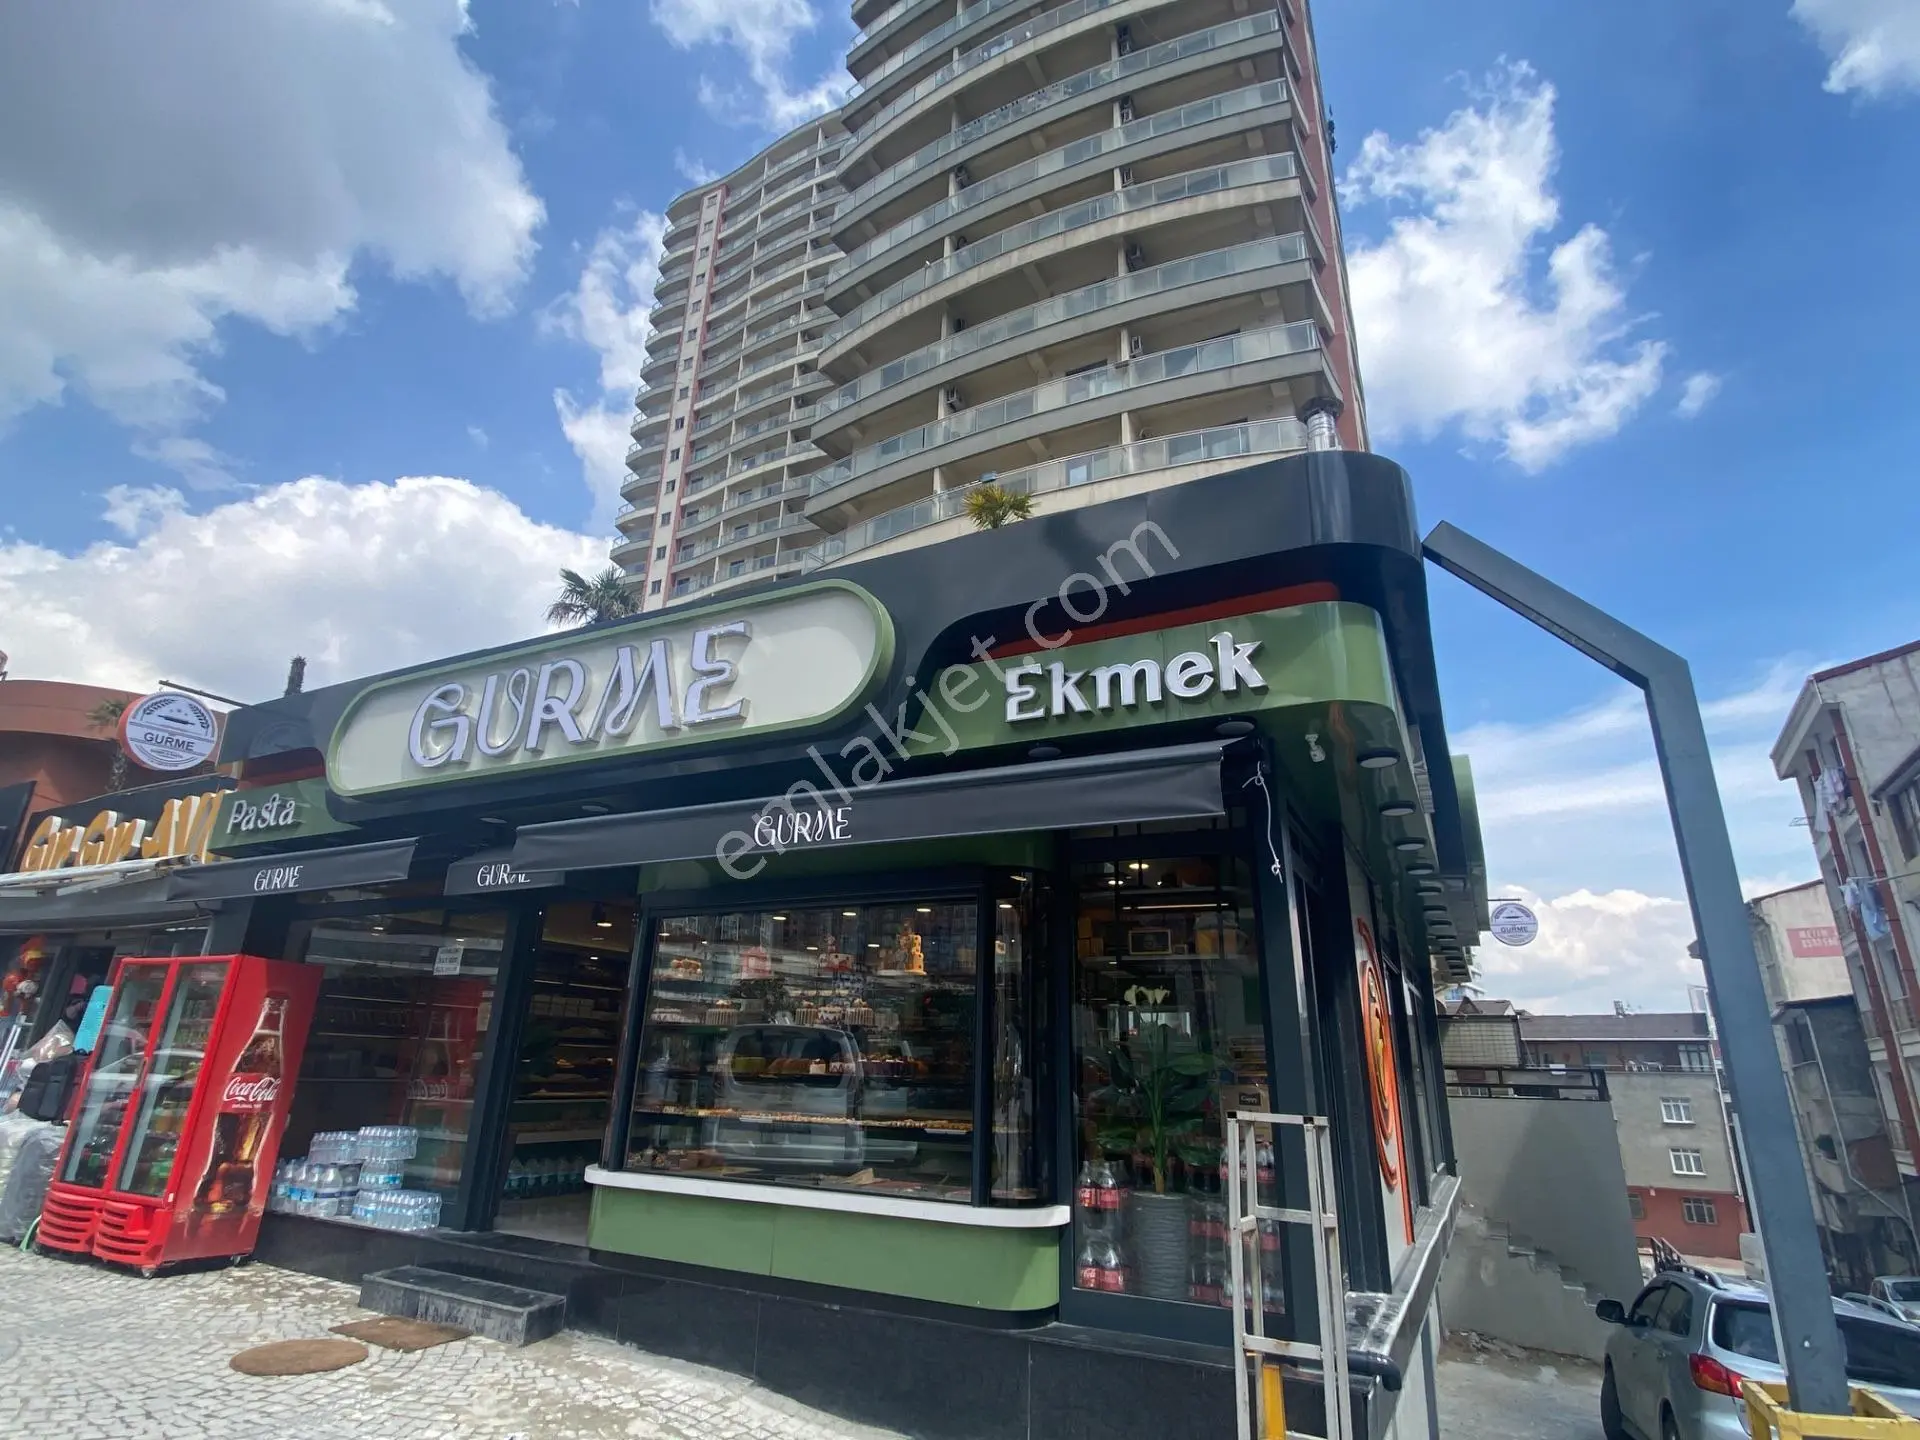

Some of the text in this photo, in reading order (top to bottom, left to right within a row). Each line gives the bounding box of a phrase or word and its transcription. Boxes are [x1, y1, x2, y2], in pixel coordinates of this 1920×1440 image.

[408, 620, 752, 768] GURME
[1004, 631, 1268, 723] Ekmek
[143, 731, 195, 752] GURME
[226, 793, 295, 833] Pasta
[754, 807, 852, 847] GURME
[253, 865, 304, 891] GURME
